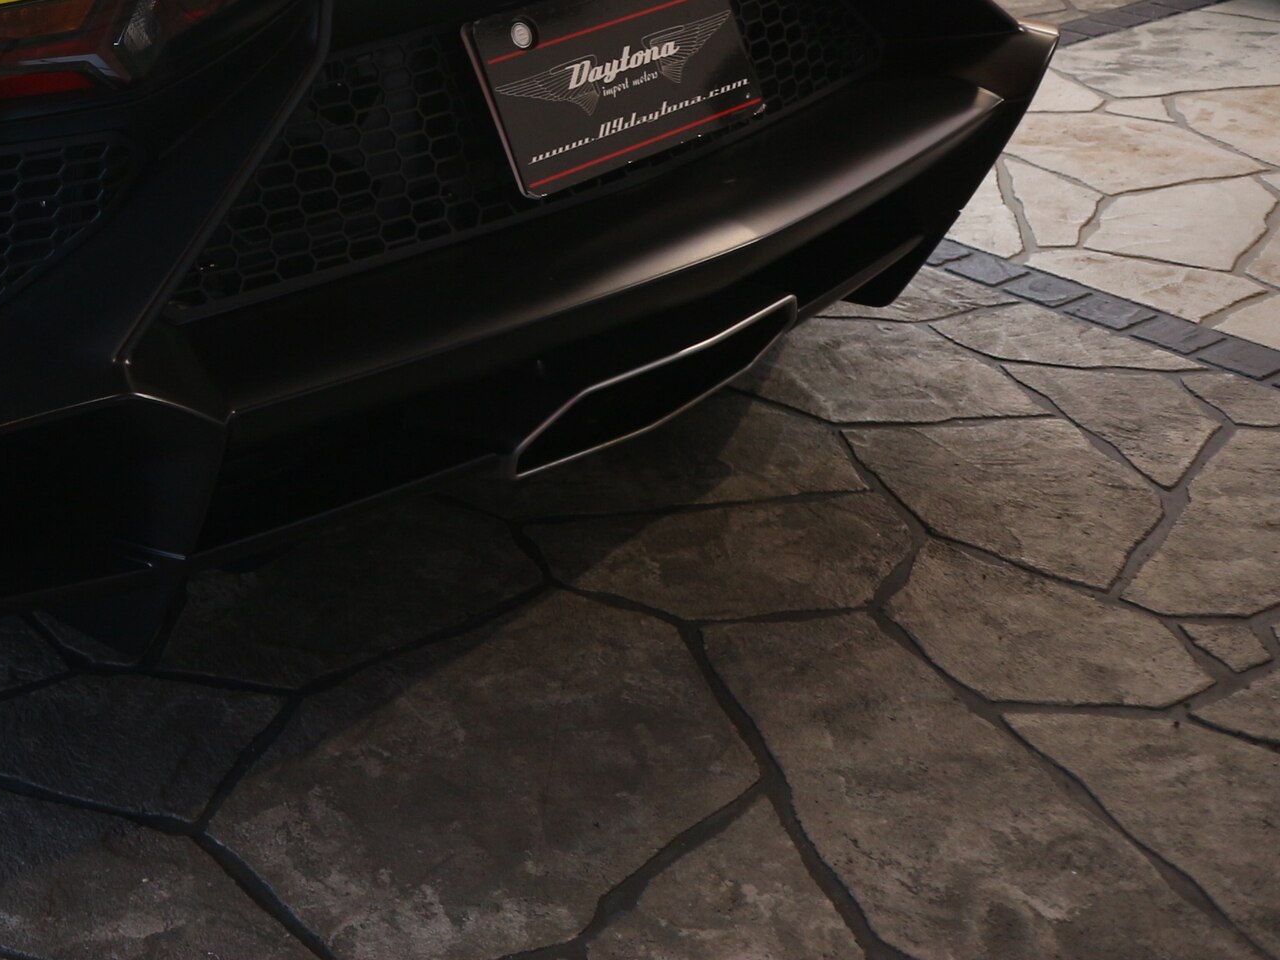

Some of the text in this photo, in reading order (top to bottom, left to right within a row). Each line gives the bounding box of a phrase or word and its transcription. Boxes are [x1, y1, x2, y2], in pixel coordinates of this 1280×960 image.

[565, 40, 680, 90] Daytona
[602, 70, 658, 98] import motors
